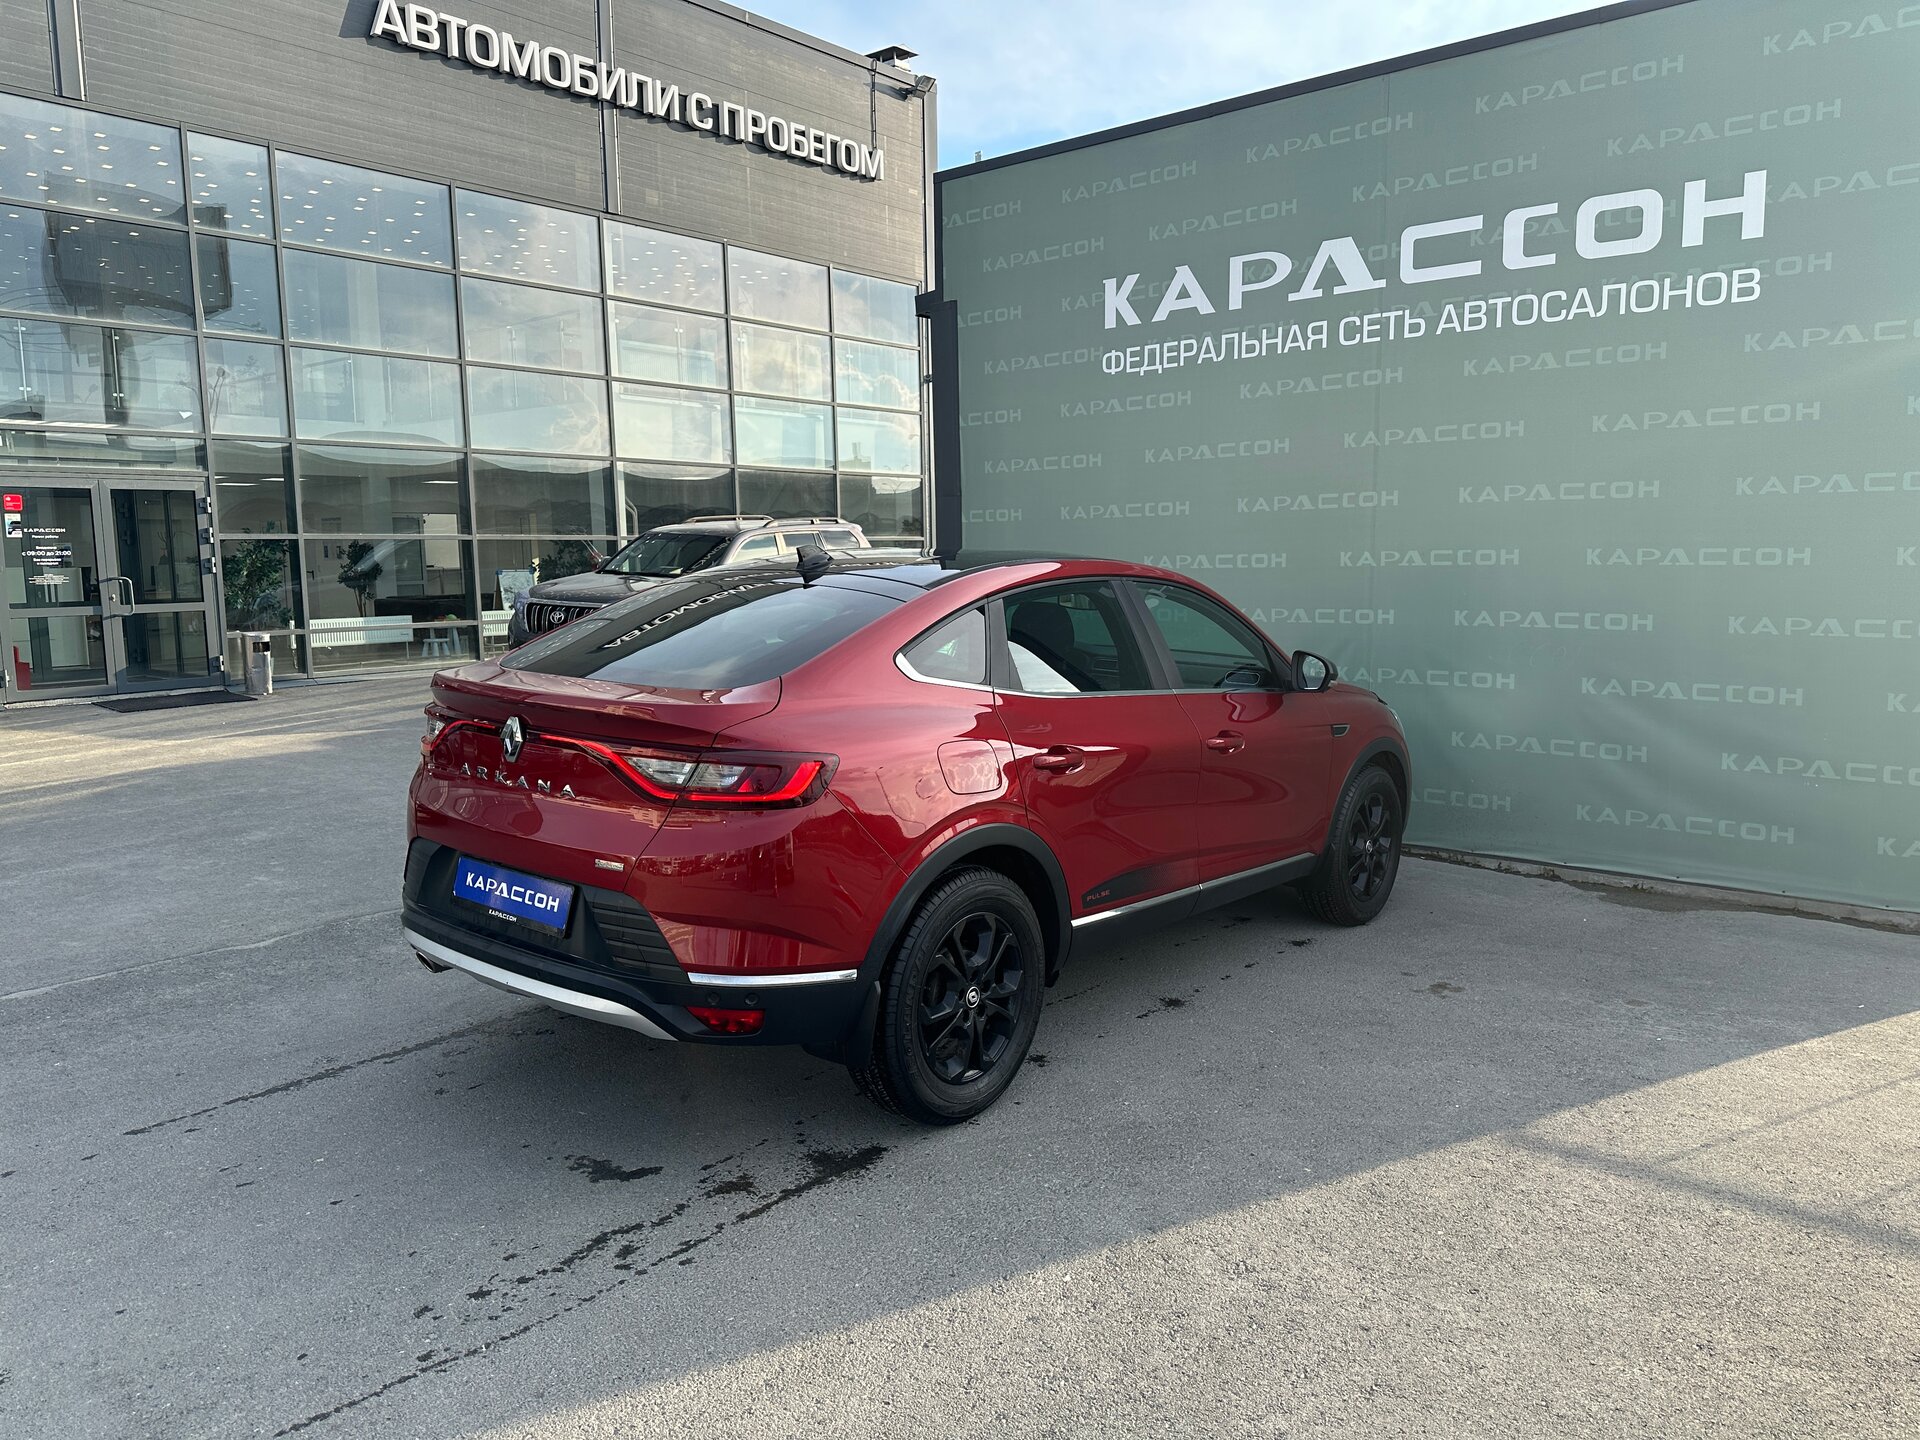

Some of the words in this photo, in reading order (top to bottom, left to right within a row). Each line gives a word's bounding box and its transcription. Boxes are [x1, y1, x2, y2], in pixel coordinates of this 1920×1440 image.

[370, 0, 679, 121] АВТОМОБИЛИ
[686, 92, 713, 130] С
[719, 100, 884, 180] ПРОБЕГОМ
[1475, 54, 1685, 115] КАРАССОН
[1245, 112, 1414, 164] КАРАССОН
[1607, 98, 1842, 157] КАРАССОН
[1061, 160, 1198, 203] КАРАССОН
[1352, 152, 1538, 203] КАРАССОН
[1149, 198, 1298, 241] КАРАССОН
[982, 236, 1105, 273] КАРАССОН
[1102, 170, 1767, 330] КАРАССОН
[1102, 319, 1328, 376] ФЕДЕРАЛЬНАЯ
[1339, 309, 1425, 346] СЕТЬ
[1435, 267, 1762, 335] АВТОСАЛОНОВ
[1744, 319, 1920, 353] КАРАС
[984, 346, 1103, 375] КАРАССОН
[1463, 341, 1668, 377] КАРАССОН
[1239, 366, 1404, 400] КАРАССОН
[1060, 390, 1192, 418] КАРАССОН
[1592, 401, 1821, 433] КАРАССОН
[1145, 437, 1290, 464] КАРАССОН
[1343, 420, 1525, 448] КАРАССОН
[984, 452, 1102, 474] КАРАССОН
[1237, 490, 1399, 514] КАРАССОН
[1459, 480, 1660, 504] КАРАССОН
[1060, 500, 1190, 521] КАРАССОН
[1340, 549, 1520, 568] КАРАССОН
[1586, 547, 1811, 567] КАРАССОН
[1454, 609, 1654, 632] КАРАССОН
[1728, 615, 1920, 639] КАРАСС
[1581, 677, 1804, 706] КАРАССОН
[1451, 731, 1648, 763] КАРАССОН
[461, 763, 576, 798] ARKANA
[1576, 804, 1795, 845] КАРАССОН
[465, 871, 560, 913] КАРАССОН
[1086, 889, 1111, 902] PULSE
